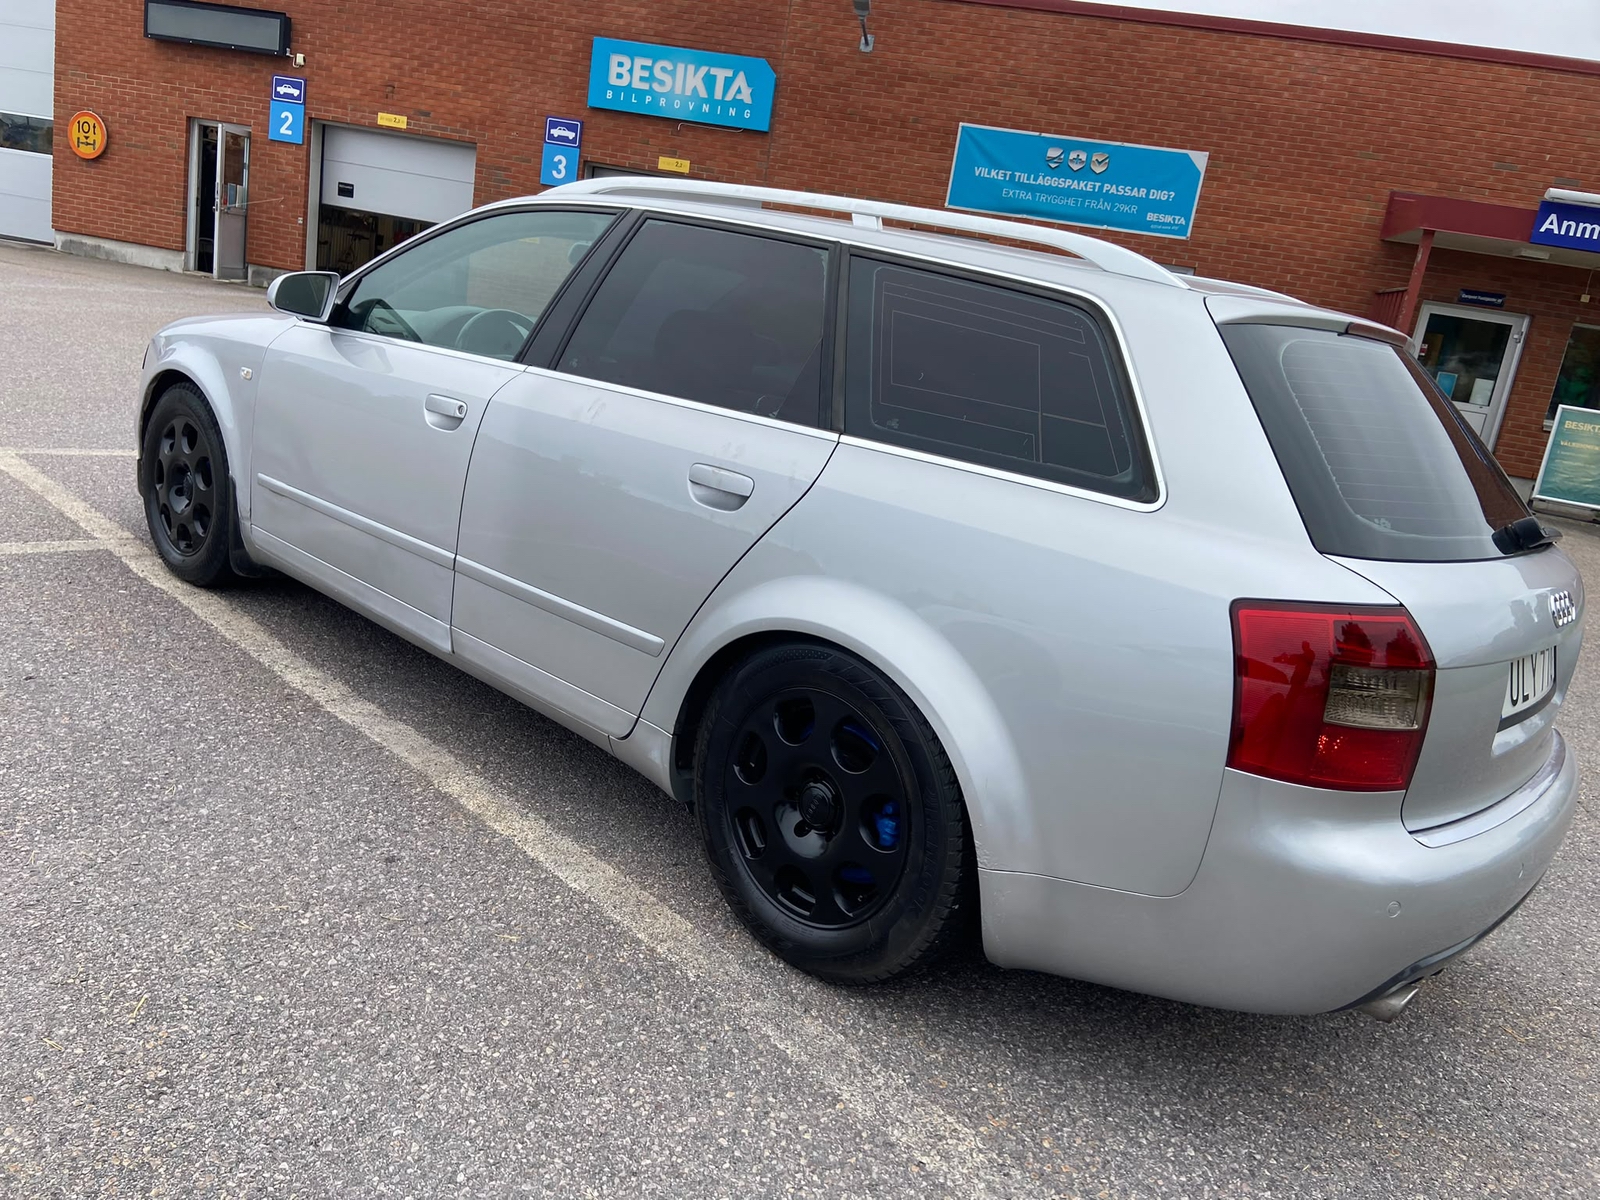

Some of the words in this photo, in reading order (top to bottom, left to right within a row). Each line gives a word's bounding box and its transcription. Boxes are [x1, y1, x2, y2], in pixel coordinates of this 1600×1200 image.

[608, 52, 754, 105] BESIKTA
[606, 89, 751, 119] BILPROVNING
[77, 120, 91, 134] 10
[92, 122, 97, 136] t
[279, 111, 293, 135] 2
[551, 155, 567, 179] 3
[974, 166, 1012, 181] VILKET
[1014, 171, 1102, 192] TILLÄGGSPAKET
[1103, 183, 1147, 198] PASSAR
[1149, 189, 1176, 202] DIG?
[1002, 188, 1033, 201] EXTRA
[1035, 193, 1083, 208] TRYGGHET
[1084, 198, 1112, 211] FRÅN
[1113, 203, 1138, 214] 29KR
[1146, 212, 1186, 225] BESIKTA
[1539, 213, 1600, 240] Anm
[1564, 420, 1600, 433] BESIKT
